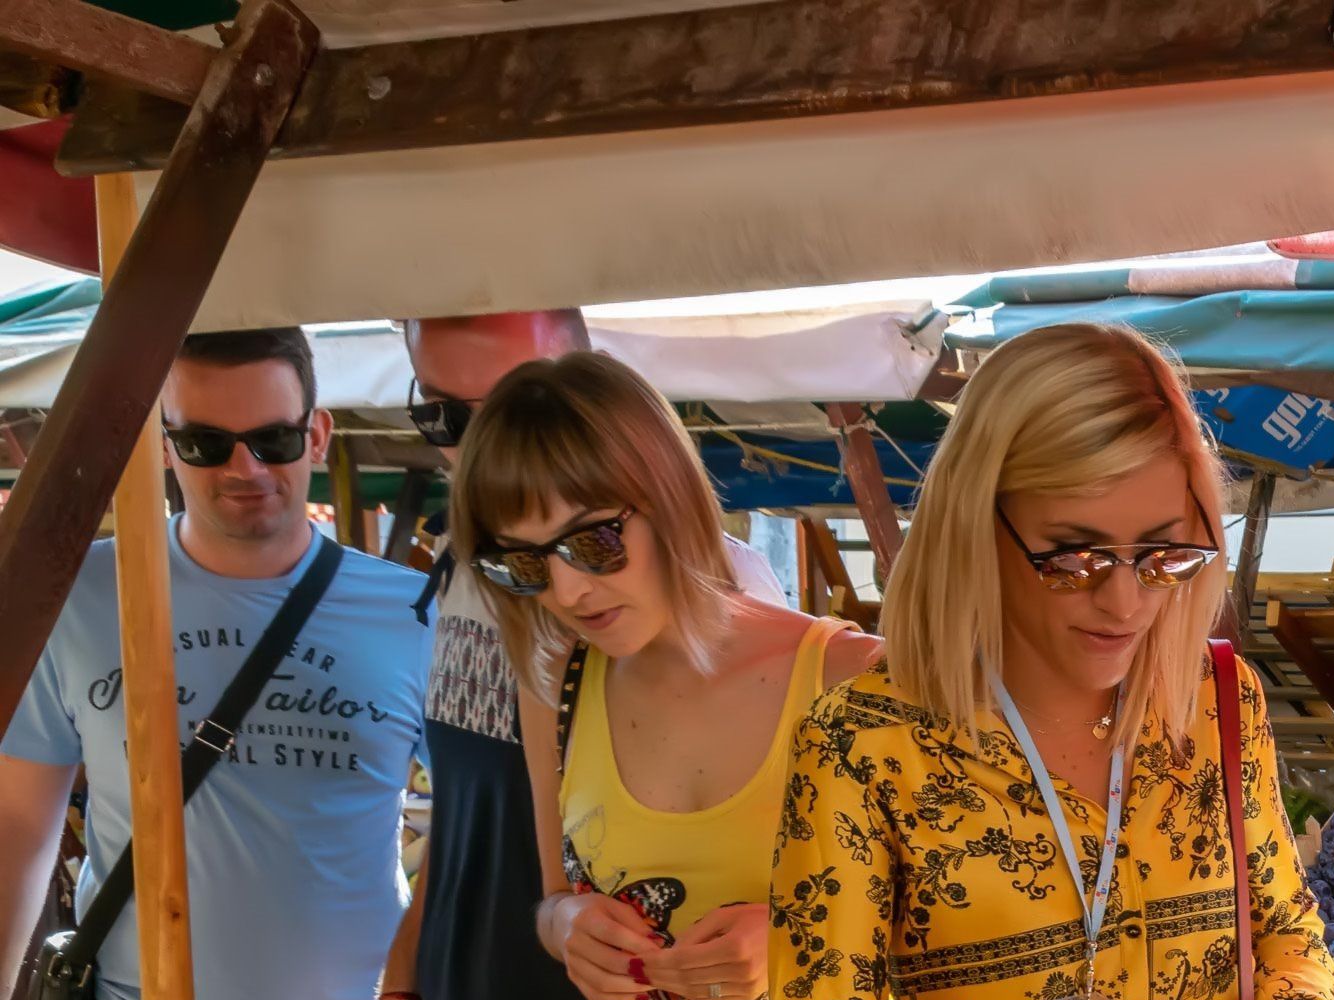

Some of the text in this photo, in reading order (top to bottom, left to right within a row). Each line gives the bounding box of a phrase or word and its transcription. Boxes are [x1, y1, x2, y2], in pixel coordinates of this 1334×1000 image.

[173, 628, 336, 672] SUAL EAR
[274, 743, 359, 772] STYLE
